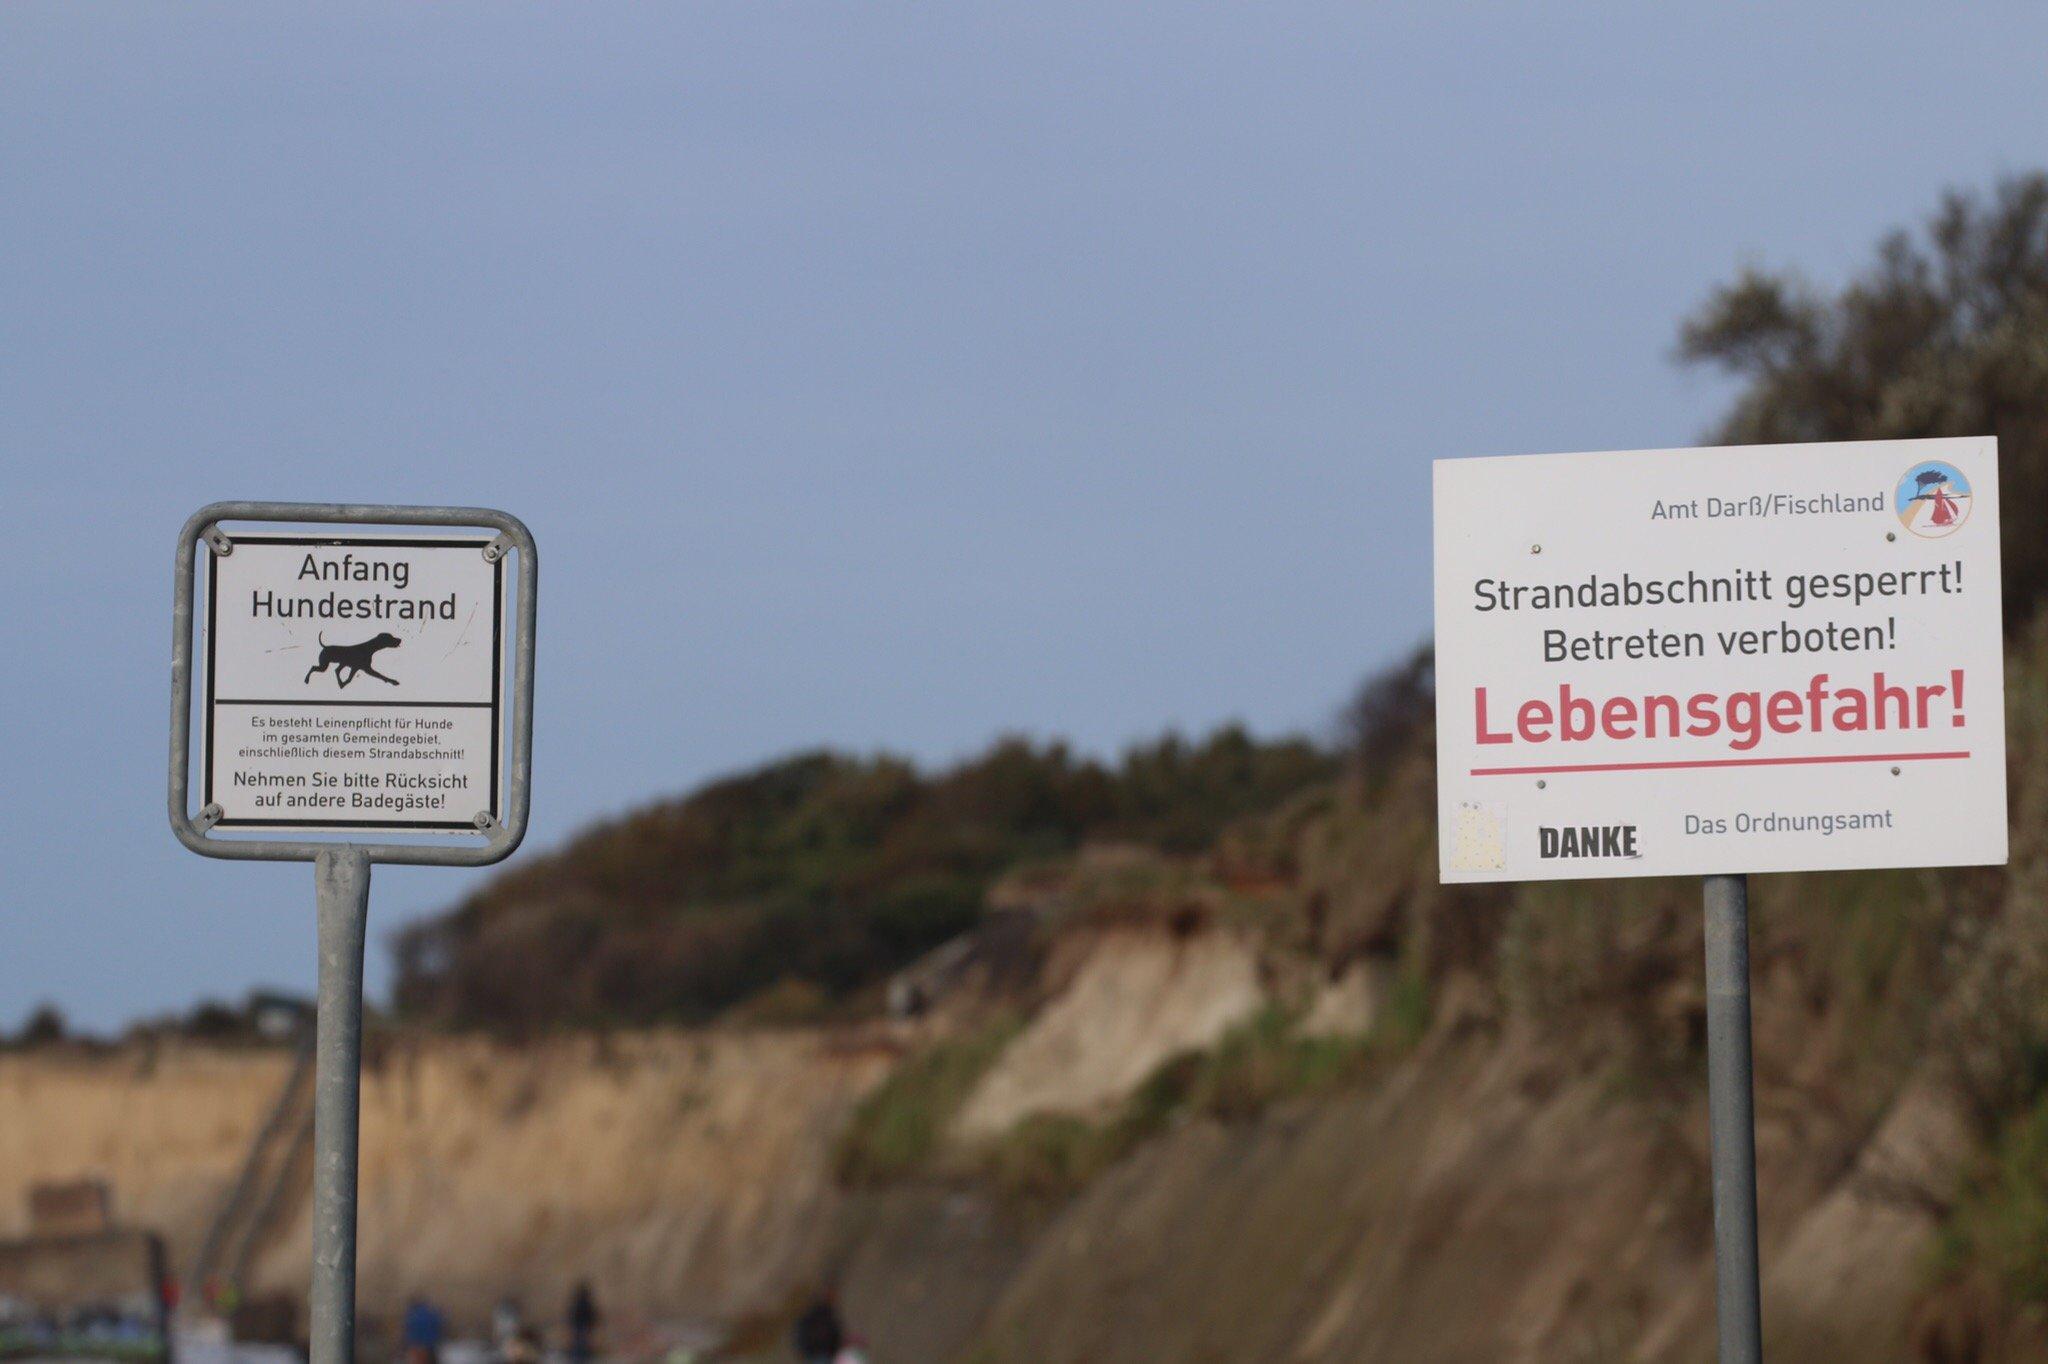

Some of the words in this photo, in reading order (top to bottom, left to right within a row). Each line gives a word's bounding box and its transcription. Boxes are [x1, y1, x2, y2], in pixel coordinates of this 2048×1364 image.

[1650, 499, 1699, 520] Amt
[1707, 491, 1884, 518] Darß/Fischland
[298, 553, 409, 589] Anfang
[1474, 568, 1773, 612] Strandabschnitt
[1786, 560, 1963, 609] gesperrt!
[252, 590, 456, 620] Hundestrand
[1543, 628, 1704, 663] Betreten
[1717, 617, 1896, 656] verboten!
[251, 716, 265, 728] Es
[269, 717, 312, 728] besteht
[315, 717, 392, 731] Leinenpflicht
[395, 718, 412, 729] für
[415, 718, 453, 729] Hunde
[1474, 669, 1966, 751] Lebensgefahr!
[238, 747, 319, 758] einschließlich
[322, 747, 366, 759] diesem
[369, 748, 465, 760] Strandabschnitt!
[262, 732, 278, 743] im
[281, 733, 340, 746] gesamten
[233, 771, 306, 787] Nehmen
[311, 771, 338, 788] Sie
[343, 772, 380, 789] bitte
[385, 772, 468, 789] Rücksicht
[254, 792, 282, 808] auf
[286, 792, 346, 808] andere
[351, 792, 446, 812] Badegäste!
[1685, 814, 1728, 835] Das
[1735, 809, 1893, 836] Ordnungsamt
[1539, 825, 1642, 859] DANKE
